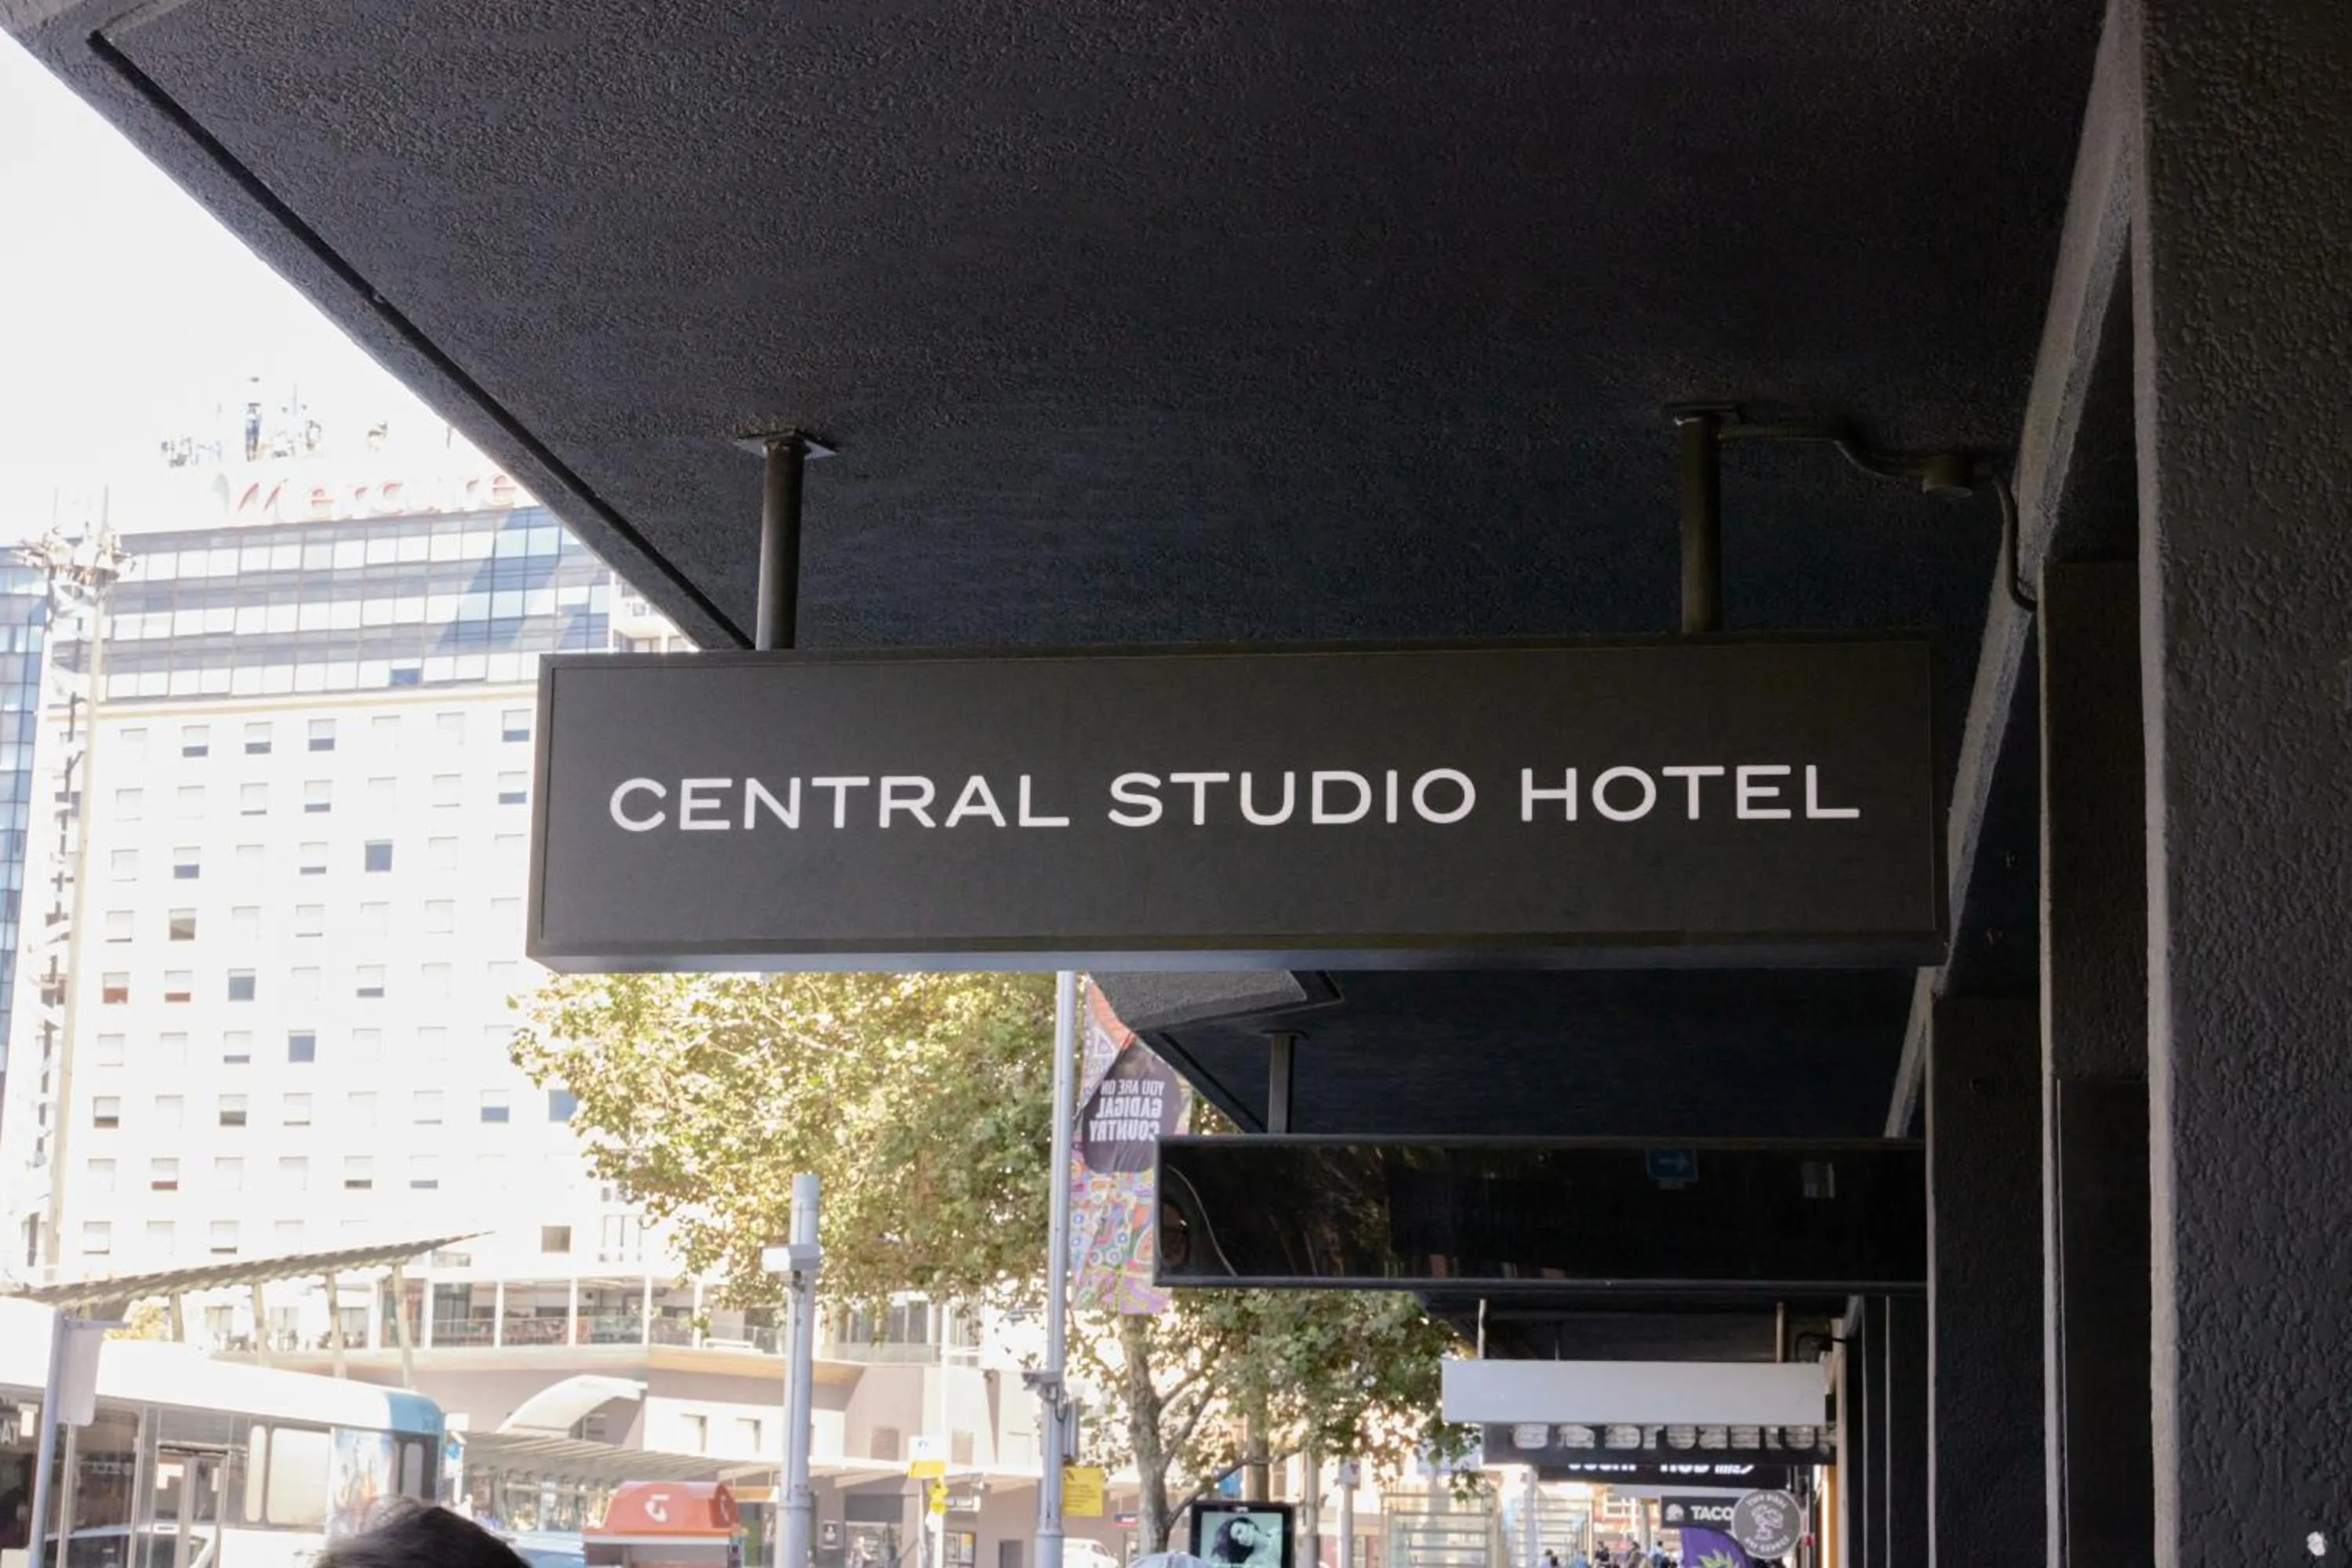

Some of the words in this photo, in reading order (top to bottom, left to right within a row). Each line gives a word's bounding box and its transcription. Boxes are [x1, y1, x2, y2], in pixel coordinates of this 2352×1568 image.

[610, 775, 1069, 832] CENTRAL
[1109, 768, 1475, 826] STUDIO
[1523, 765, 1859, 821] HOTEL
[1690, 1505, 1735, 1521] TACO
